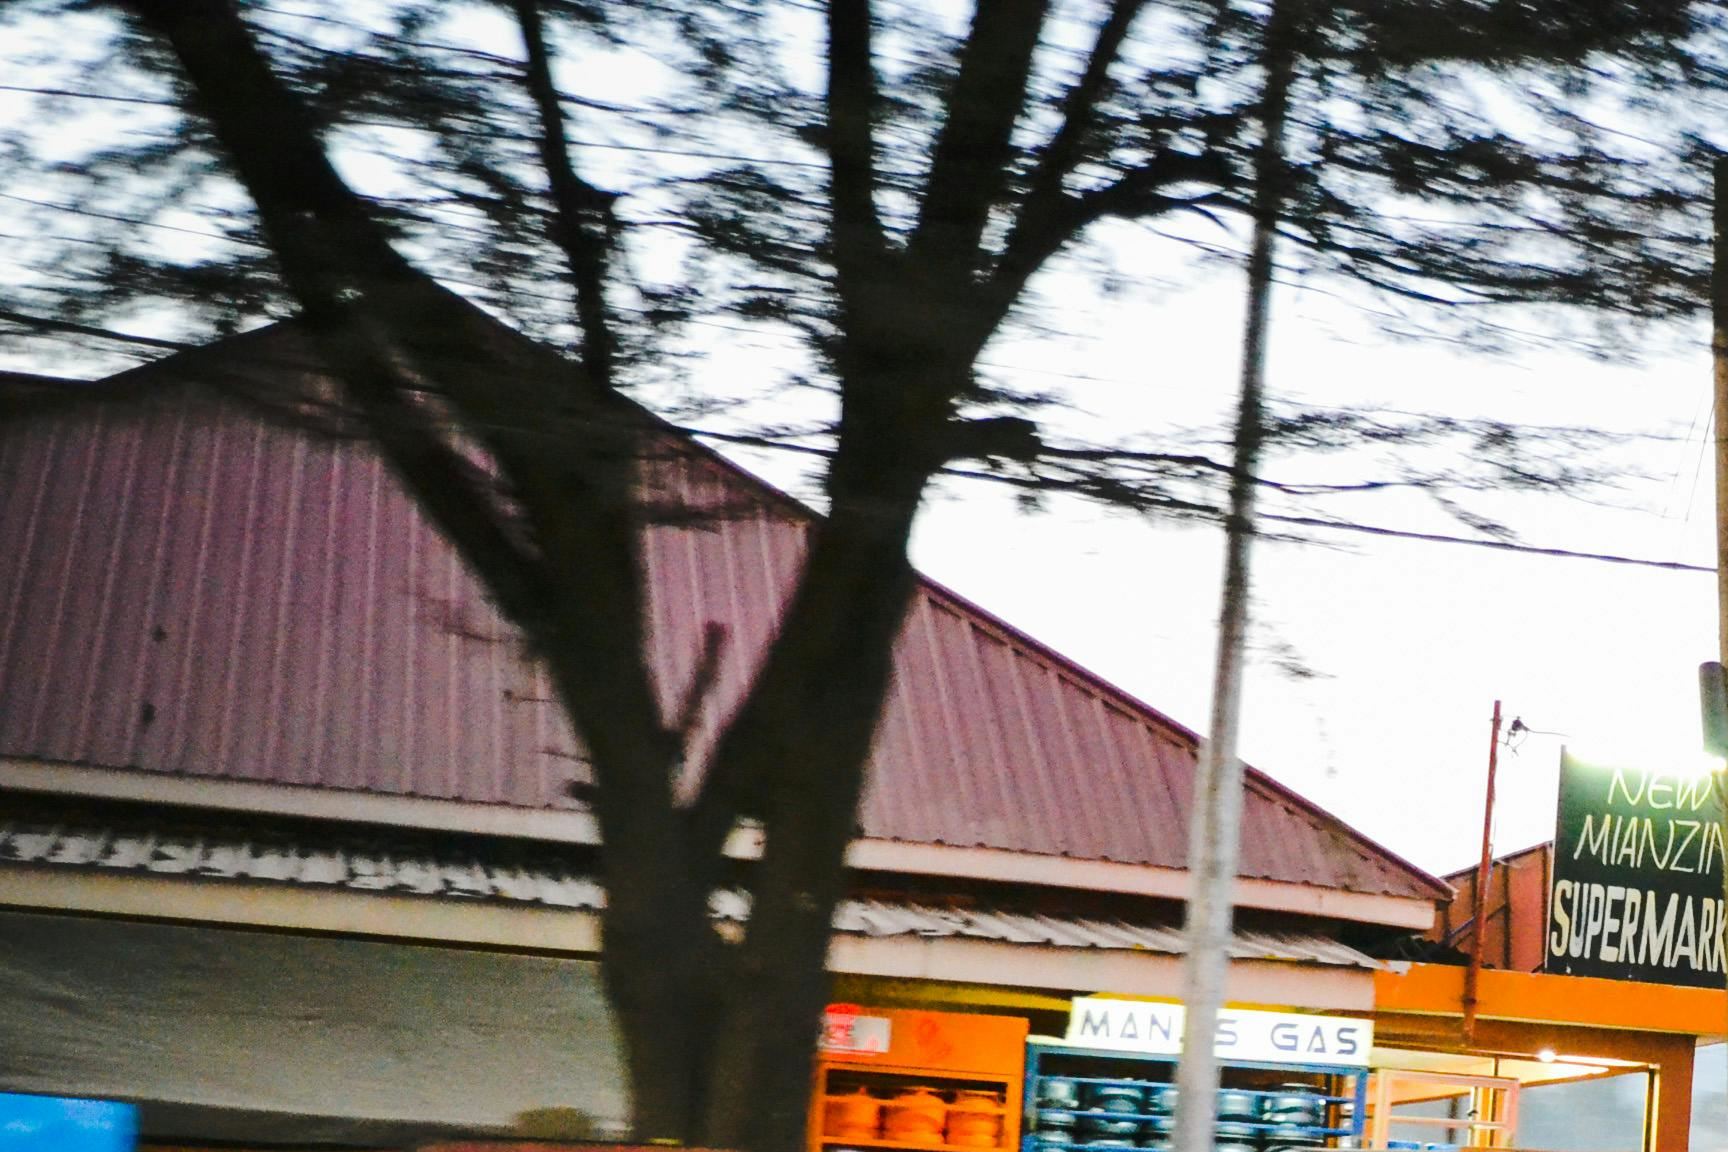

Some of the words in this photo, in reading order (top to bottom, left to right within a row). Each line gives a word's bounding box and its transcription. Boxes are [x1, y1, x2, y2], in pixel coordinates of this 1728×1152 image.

[1607, 766, 1714, 811] NEW
[1572, 813, 1727, 875] MIANZIN
[1270, 1022, 1359, 1055] GAS
